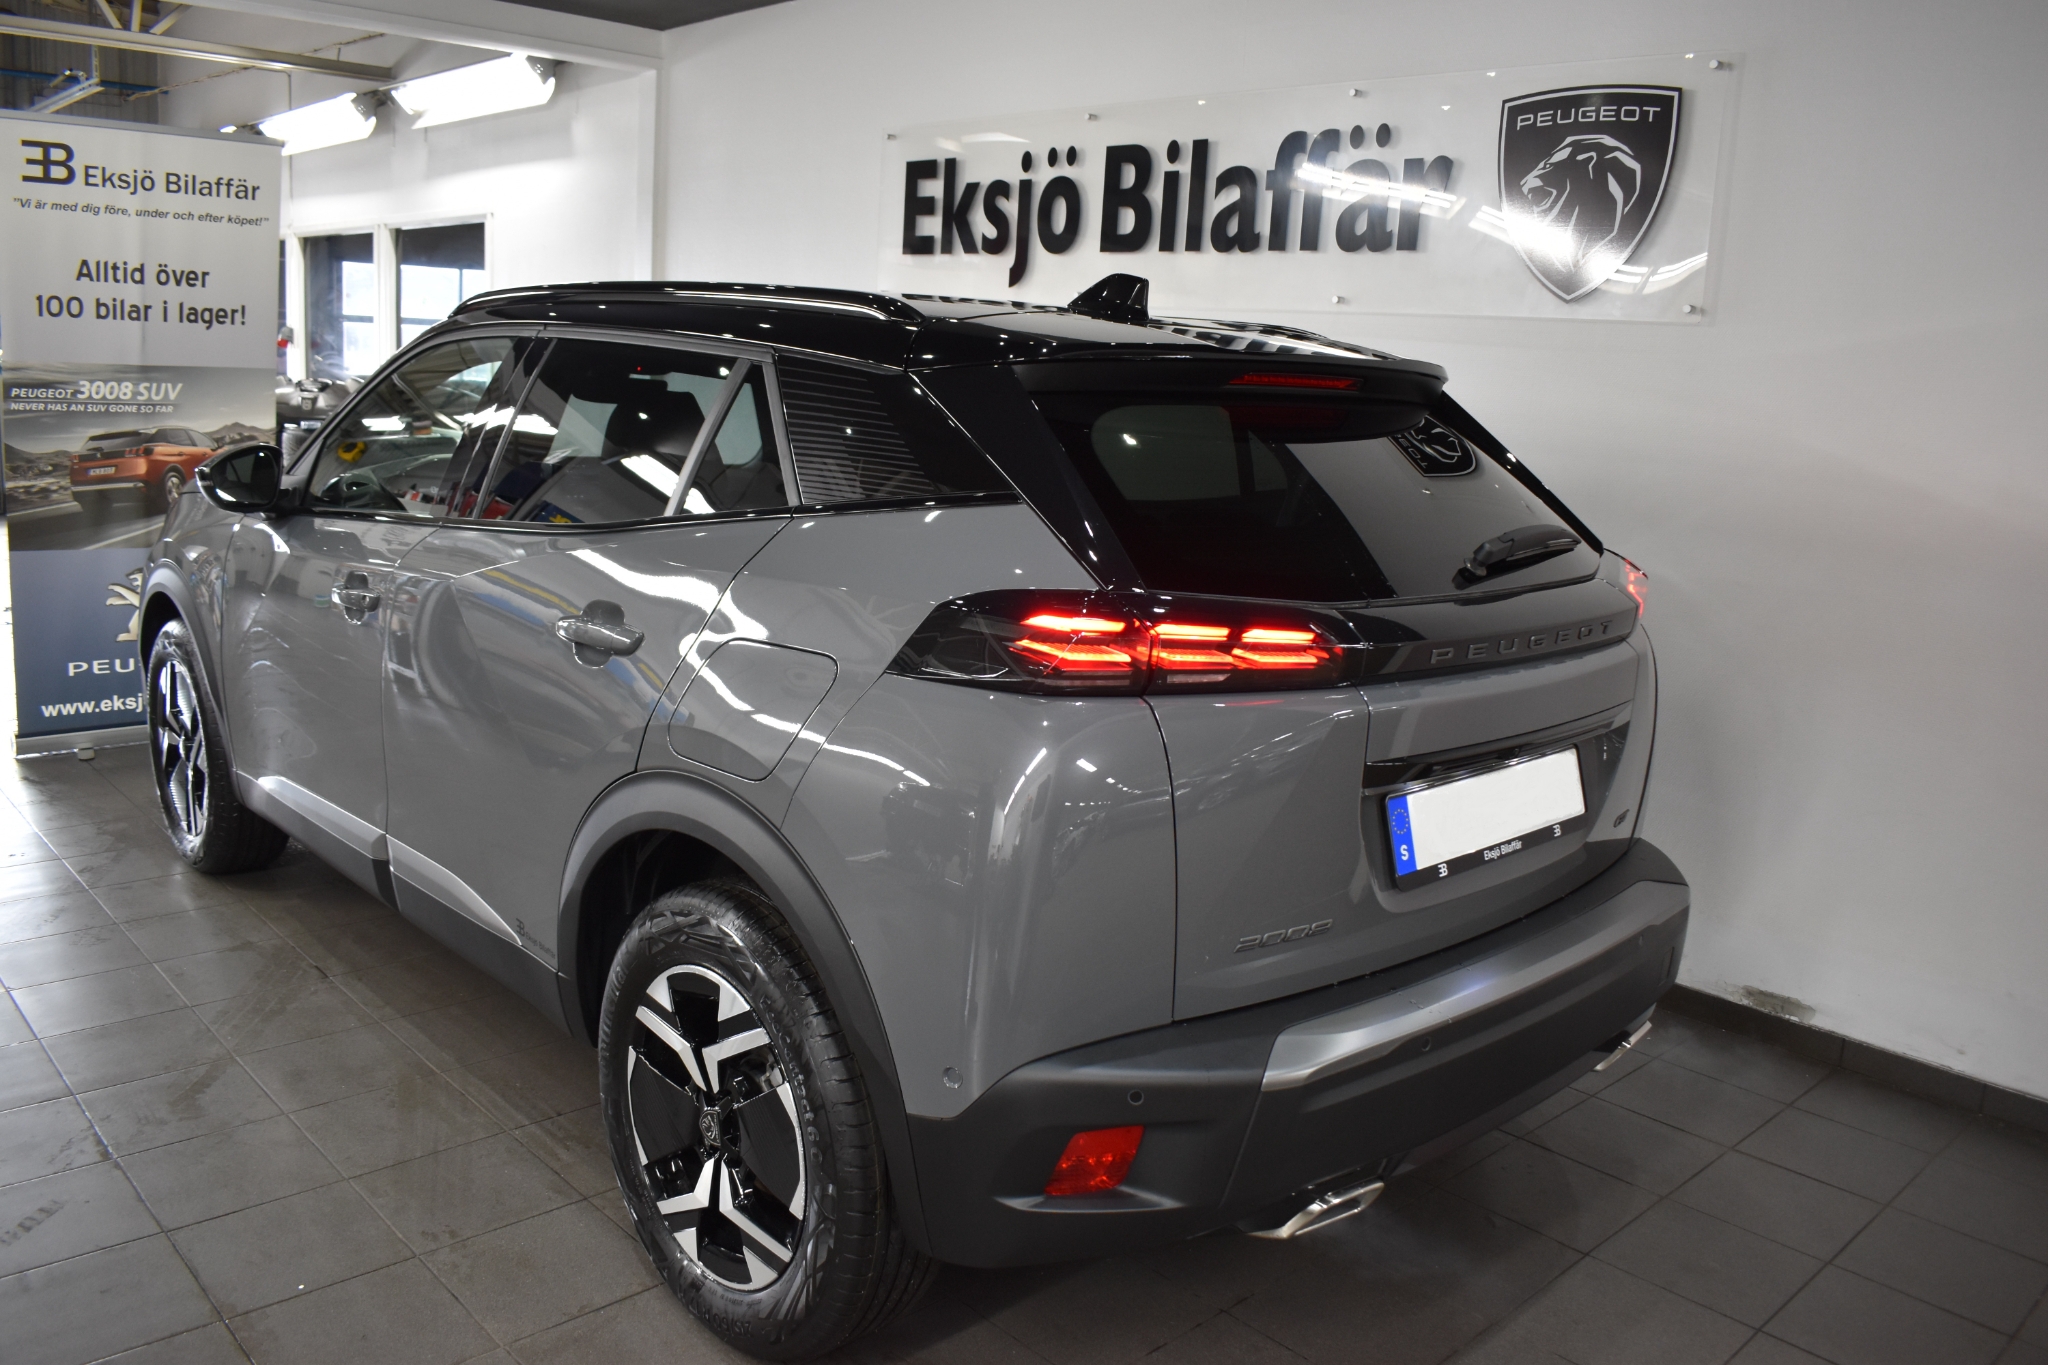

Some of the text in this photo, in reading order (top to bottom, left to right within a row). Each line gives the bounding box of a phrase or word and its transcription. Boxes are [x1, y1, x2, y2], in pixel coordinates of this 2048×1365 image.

[1516, 105, 1661, 131] PEUGEOT
[83, 165, 156, 195] Eksjö
[165, 172, 260, 200] Bilaffär
[35, 200, 48, 209] är
[50, 202, 78, 212] med
[81, 203, 101, 216] dig
[104, 204, 131, 217] före,
[135, 208, 170, 219] under
[172, 211, 195, 221] och
[198, 212, 224, 223] efter
[902, 122, 1456, 287] Eksjö Bilaffär
[76, 259, 210, 288] Alltid över
[35, 294, 246, 330] 100 bilar i lager!
[11, 380, 183, 400] PEUGEOT 3008 SUV
[10, 402, 174, 413] NEVER HAS AN SUV GONE SO FAR
[1430, 619, 1614, 664] PEUGEOT
[1400, 844, 1409, 861] S
[1484, 839, 1522, 861] Eksjö Bilaffär
